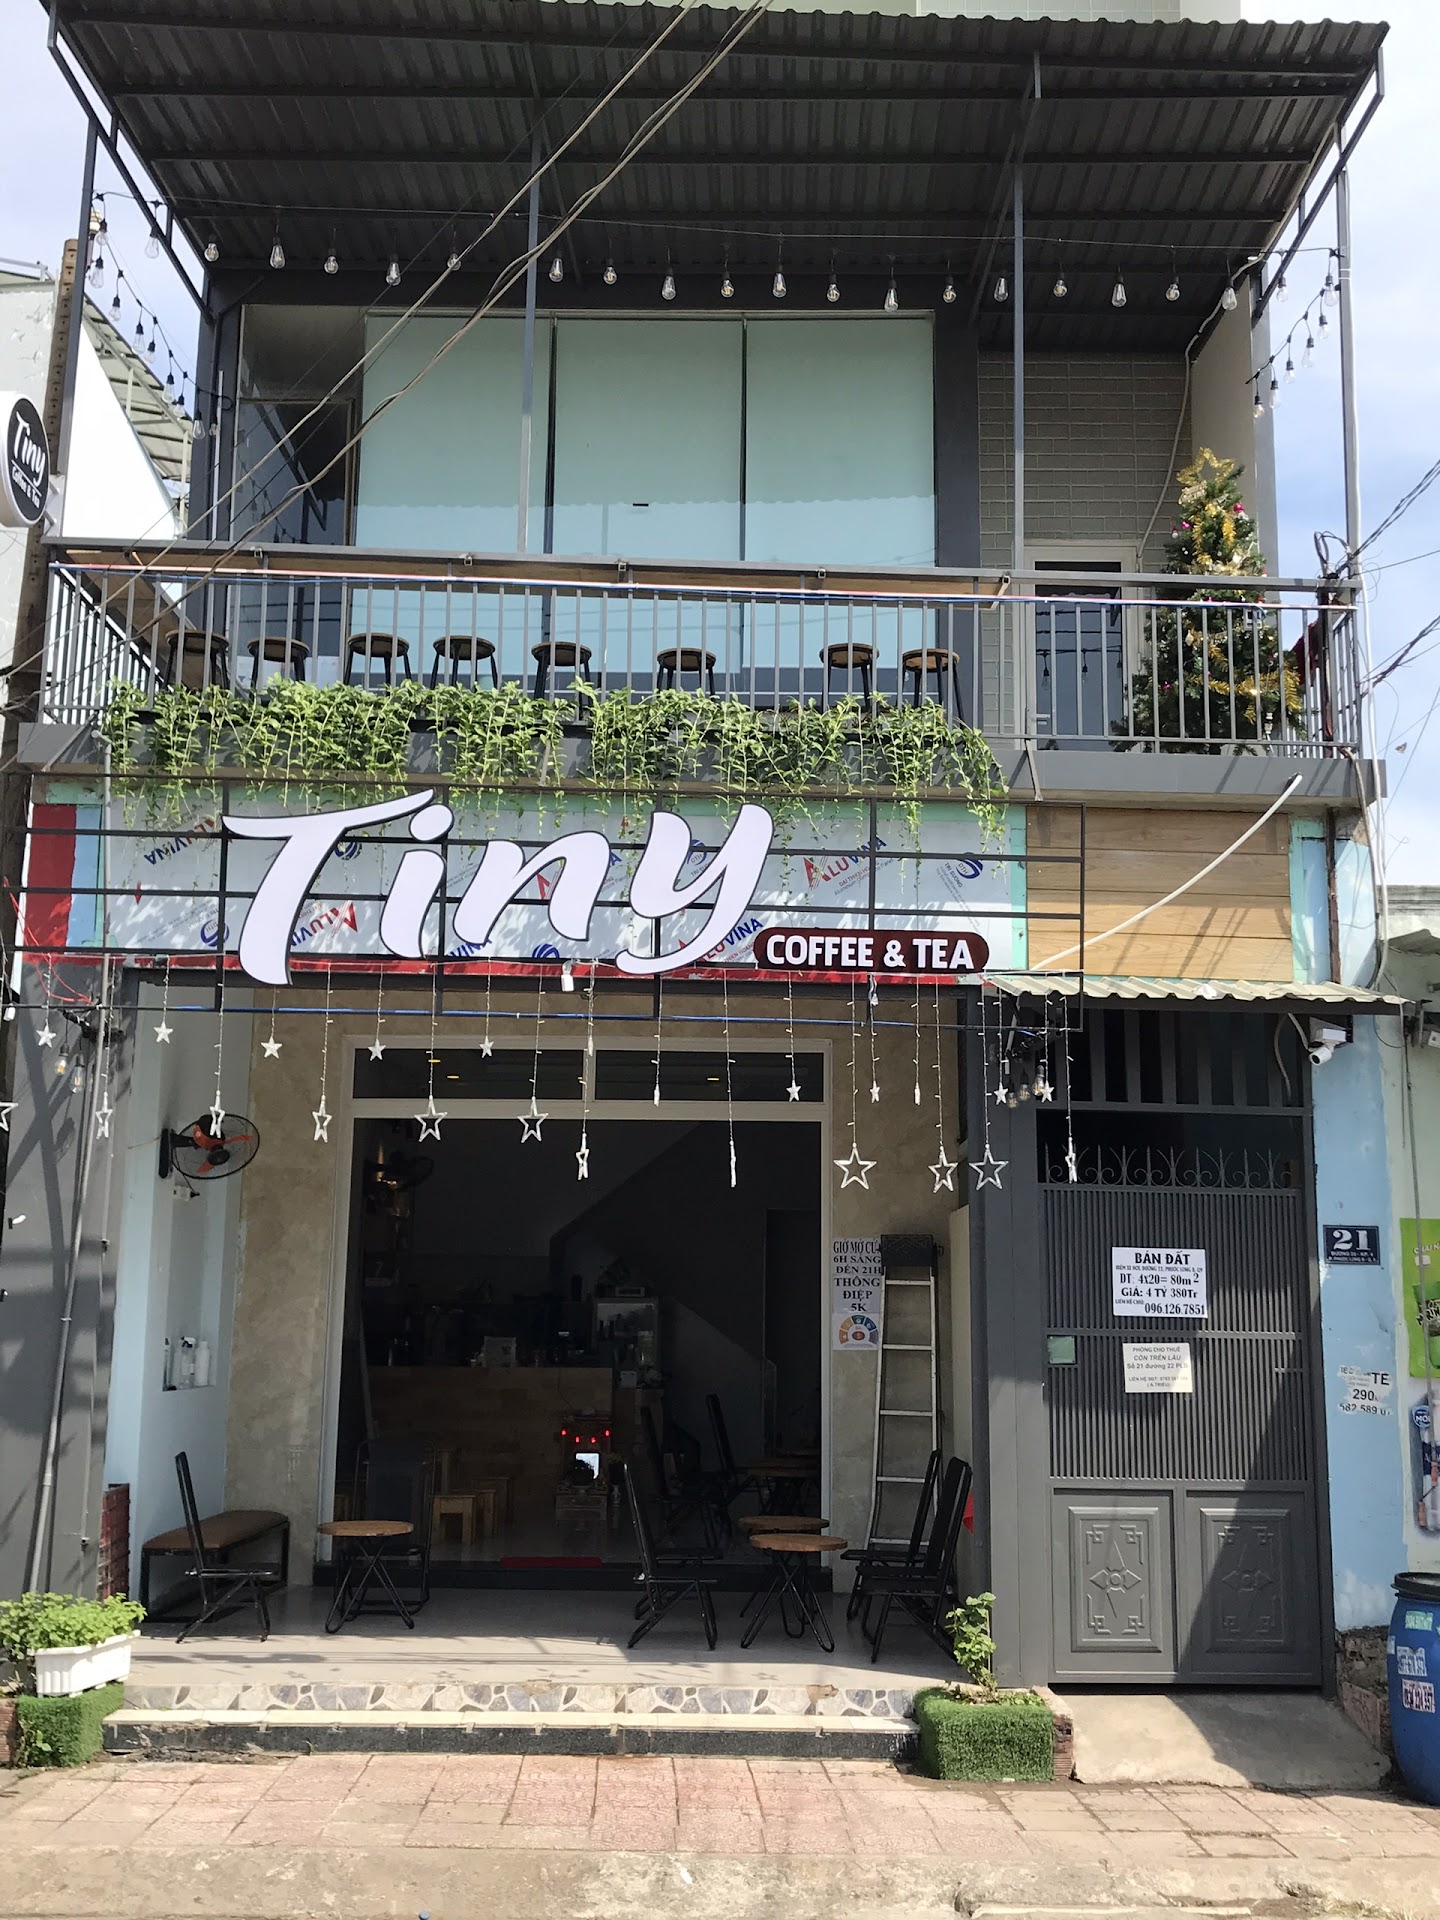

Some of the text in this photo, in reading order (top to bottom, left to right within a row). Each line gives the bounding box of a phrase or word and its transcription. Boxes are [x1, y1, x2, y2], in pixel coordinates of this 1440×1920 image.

[14, 411, 46, 488] Tiny
[12, 466, 27, 492] Coffee
[32, 489, 40, 508] Tea
[222, 788, 774, 985] Tiny
[766, 934, 974, 970] COFFEE & TEA
[1332, 1229, 1371, 1250] 21
[833, 1255, 848, 1263] 6H
[1135, 1250, 1190, 1265] BÁN ĐẤT
[862, 1266, 881, 1274] 21H
[834, 1275, 880, 1287] THÔNG
[843, 1289, 872, 1302] ĐIỆP
[1146, 1288, 1151, 1297] 4
[851, 1303, 867, 1312] 5K
[1144, 1303, 1205, 1315] 096.126.7851
